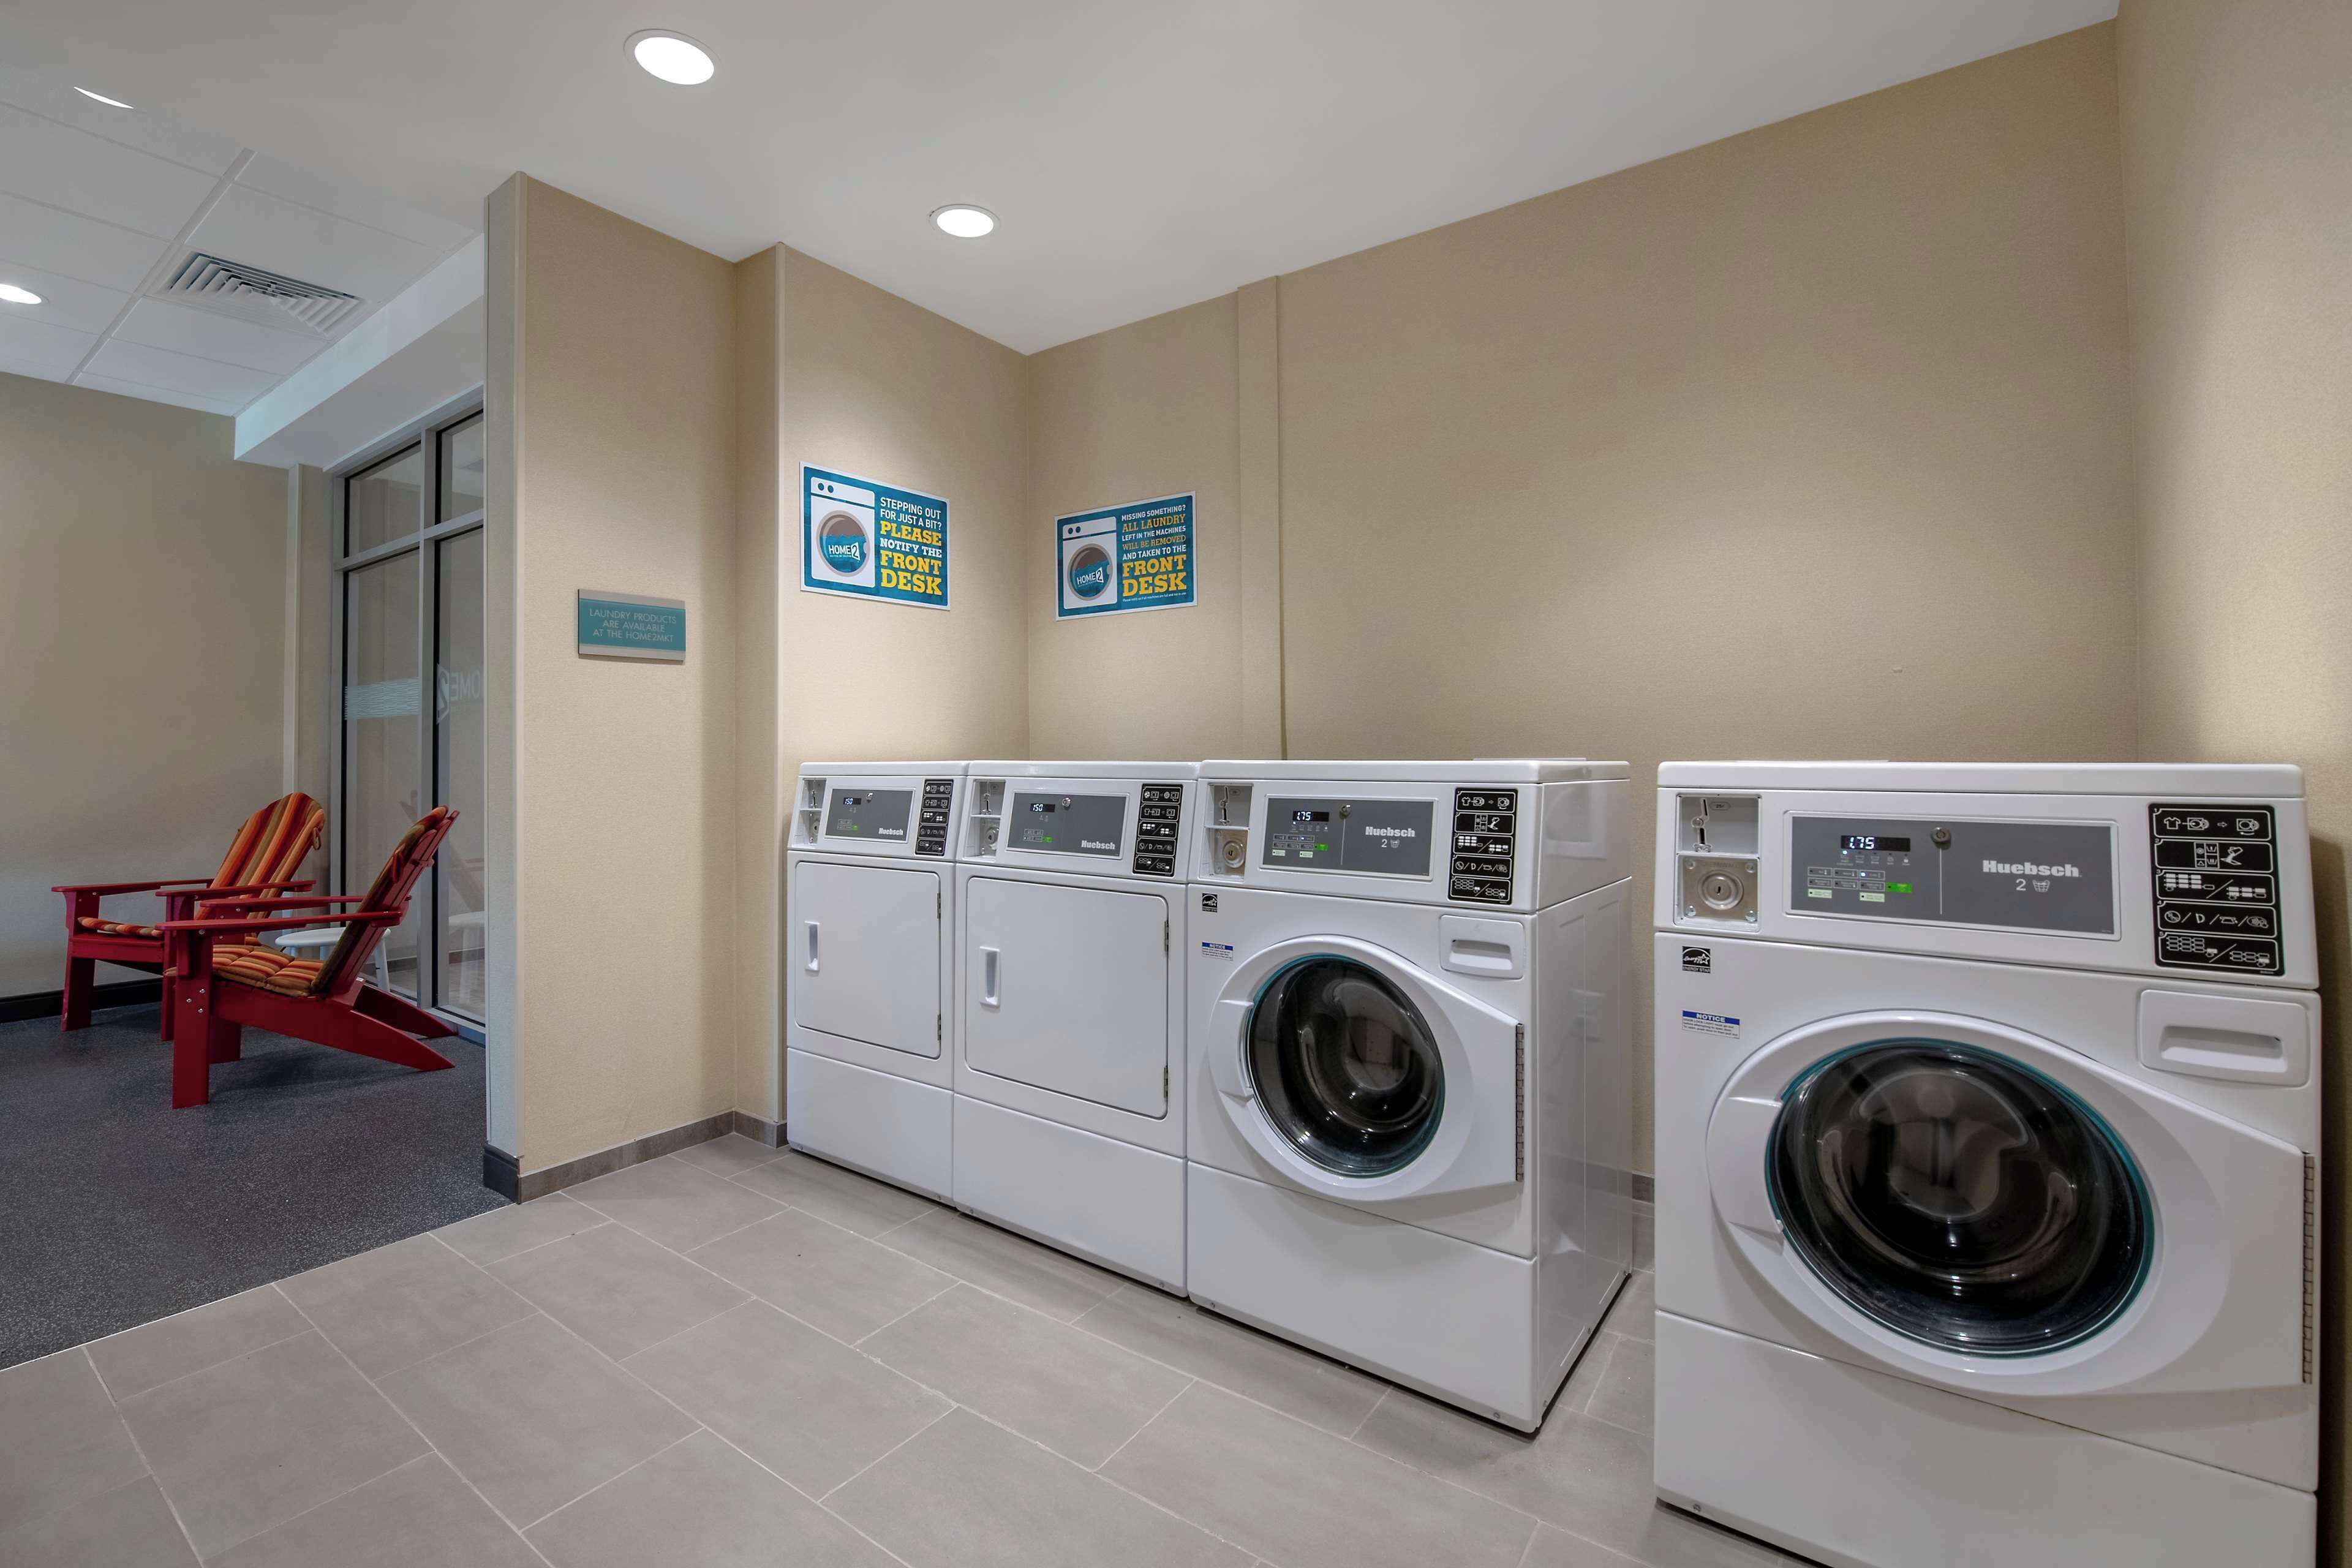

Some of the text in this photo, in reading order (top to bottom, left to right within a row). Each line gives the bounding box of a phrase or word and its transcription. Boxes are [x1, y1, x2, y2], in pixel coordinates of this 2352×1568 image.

[880, 497, 941, 519] STEPPING OUT
[1121, 505, 1186, 521] MISSING SOMETHING?
[880, 509, 941, 530] FOR JUST A BIT?
[1122, 514, 1186, 532] ALL LAUNDRY
[880, 521, 941, 546] PLEASE
[1156, 526, 1186, 536] MACHINES
[880, 538, 942, 558] NOTIFY THE
[1151, 535, 1186, 546] REMOVED
[1123, 552, 1136, 560] AND
[1138, 548, 1160, 558] TAKEN
[880, 550, 941, 575] FRONT
[1122, 554, 1186, 578] FRONT
[881, 568, 942, 595] DESK
[1123, 572, 1186, 597] DESK
[589, 608, 677, 624] LAUNDRY PRODUCTS
[603, 620, 665, 632] ARE AVAILABLE
[608, 629, 623, 638] THE
[626, 631, 674, 643] HOME2MKT
[1365, 826, 1415, 838] Huebsch
[1081, 840, 1115, 850] Huebsch
[1381, 839, 1387, 848] 2
[1849, 837, 1875, 850] 1.75
[1982, 859, 2080, 878] Huebsch
[2016, 879, 2026, 891] 2
[1696, 1013, 1725, 1022] NOTICE
